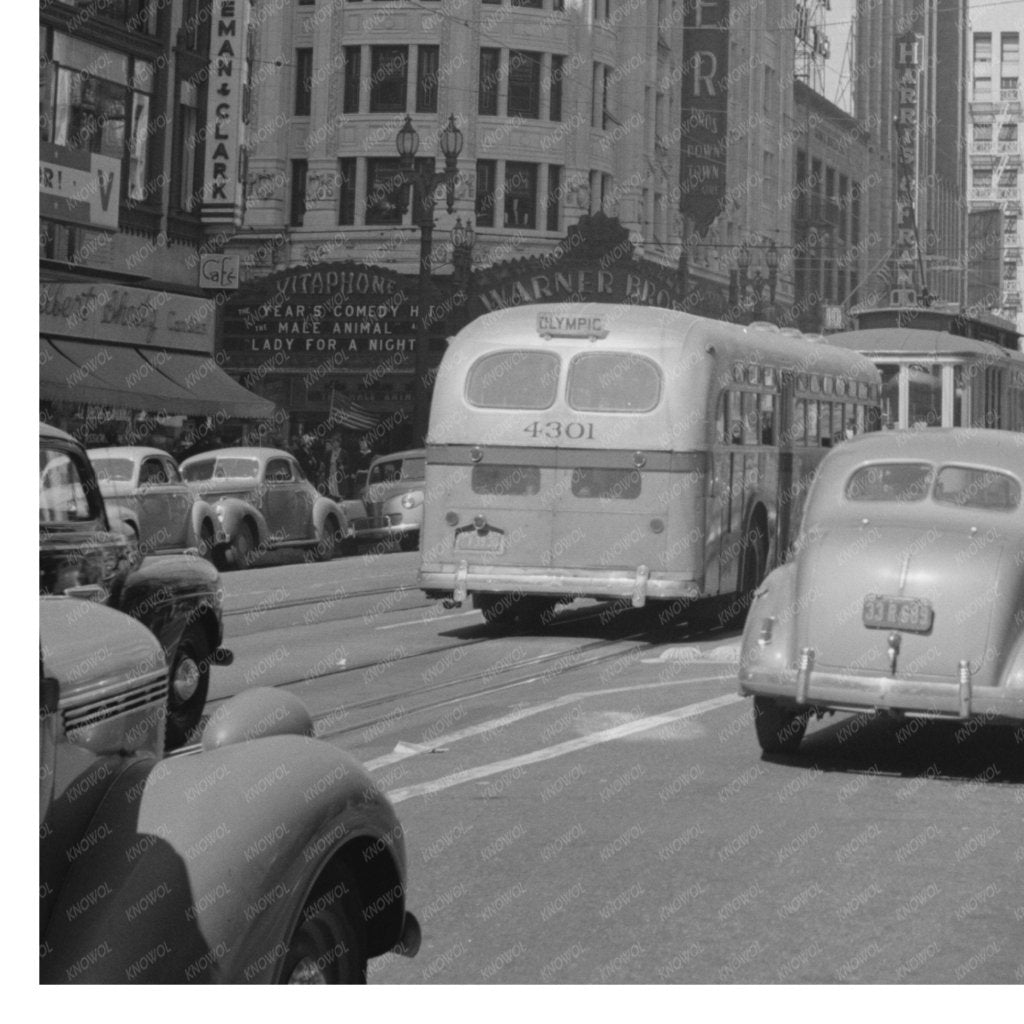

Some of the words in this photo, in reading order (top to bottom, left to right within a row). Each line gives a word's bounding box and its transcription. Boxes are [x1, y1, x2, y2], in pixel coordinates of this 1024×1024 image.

[211, 103, 231, 200] CLARK
[97, 169, 115, 212] V
[276, 271, 397, 295] VITAPHONE
[478, 270, 615, 312] WARNER
[333, 304, 399, 317] COMEDY
[278, 322, 321, 334] MALE
[333, 322, 392, 334] ANIMAL
[539, 315, 603, 332] OLYMPIC
[252, 339, 295, 351] LADY
[306, 339, 337, 351] FOR
[349, 339, 358, 351] A
[369, 339, 417, 351] NIGHT
[523, 420, 595, 440] 4301
